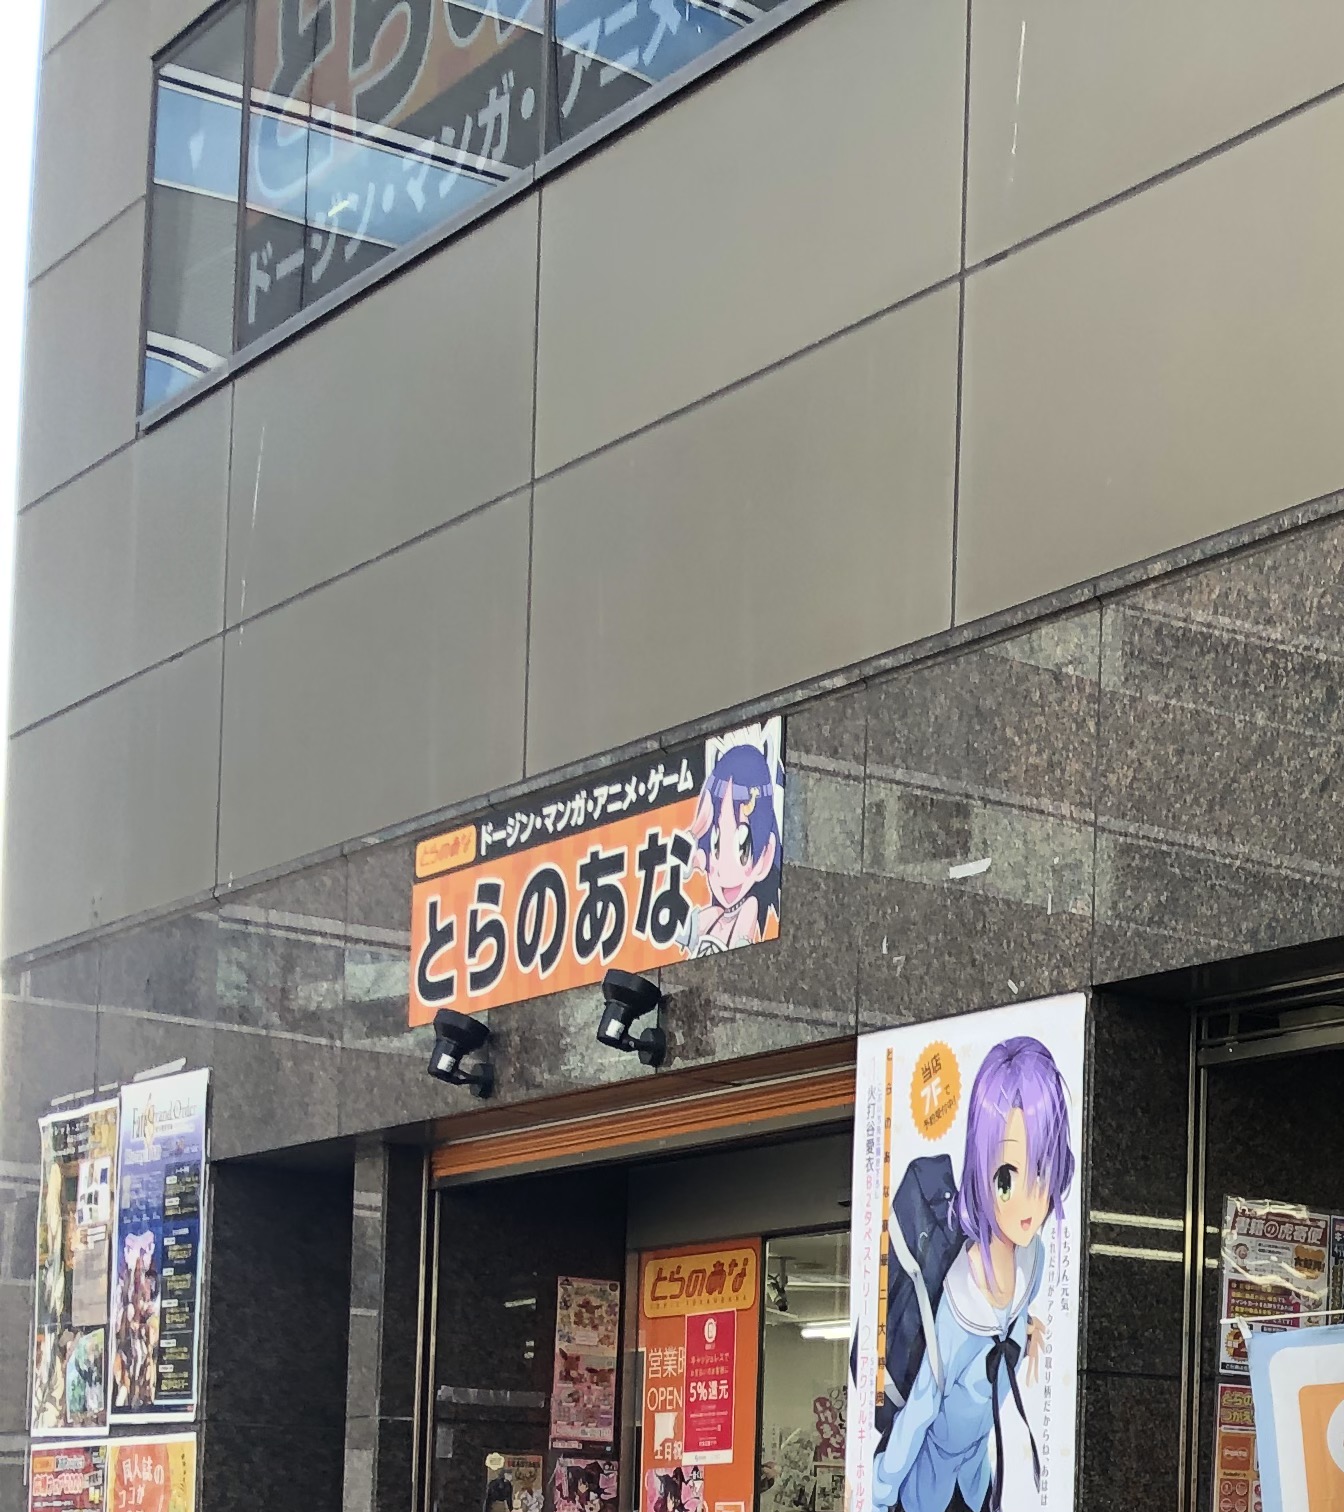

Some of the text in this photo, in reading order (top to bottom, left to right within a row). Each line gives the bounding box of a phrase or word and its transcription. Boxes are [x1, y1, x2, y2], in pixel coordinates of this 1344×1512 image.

[480, 758, 695, 857] ドージン・マンガ・アニメ・ゲーム
[415, 828, 696, 1007] とらのあな
[921, 1053, 942, 1084] 当店
[920, 1077, 943, 1116] 7F
[651, 1257, 749, 1302] とらのあな
[1060, 1226, 1072, 1318] もちろん元気。
[647, 1386, 684, 1411] OPEN
[689, 1379, 729, 1403] 5%還元
[121, 1453, 165, 1486] 同人誌の
